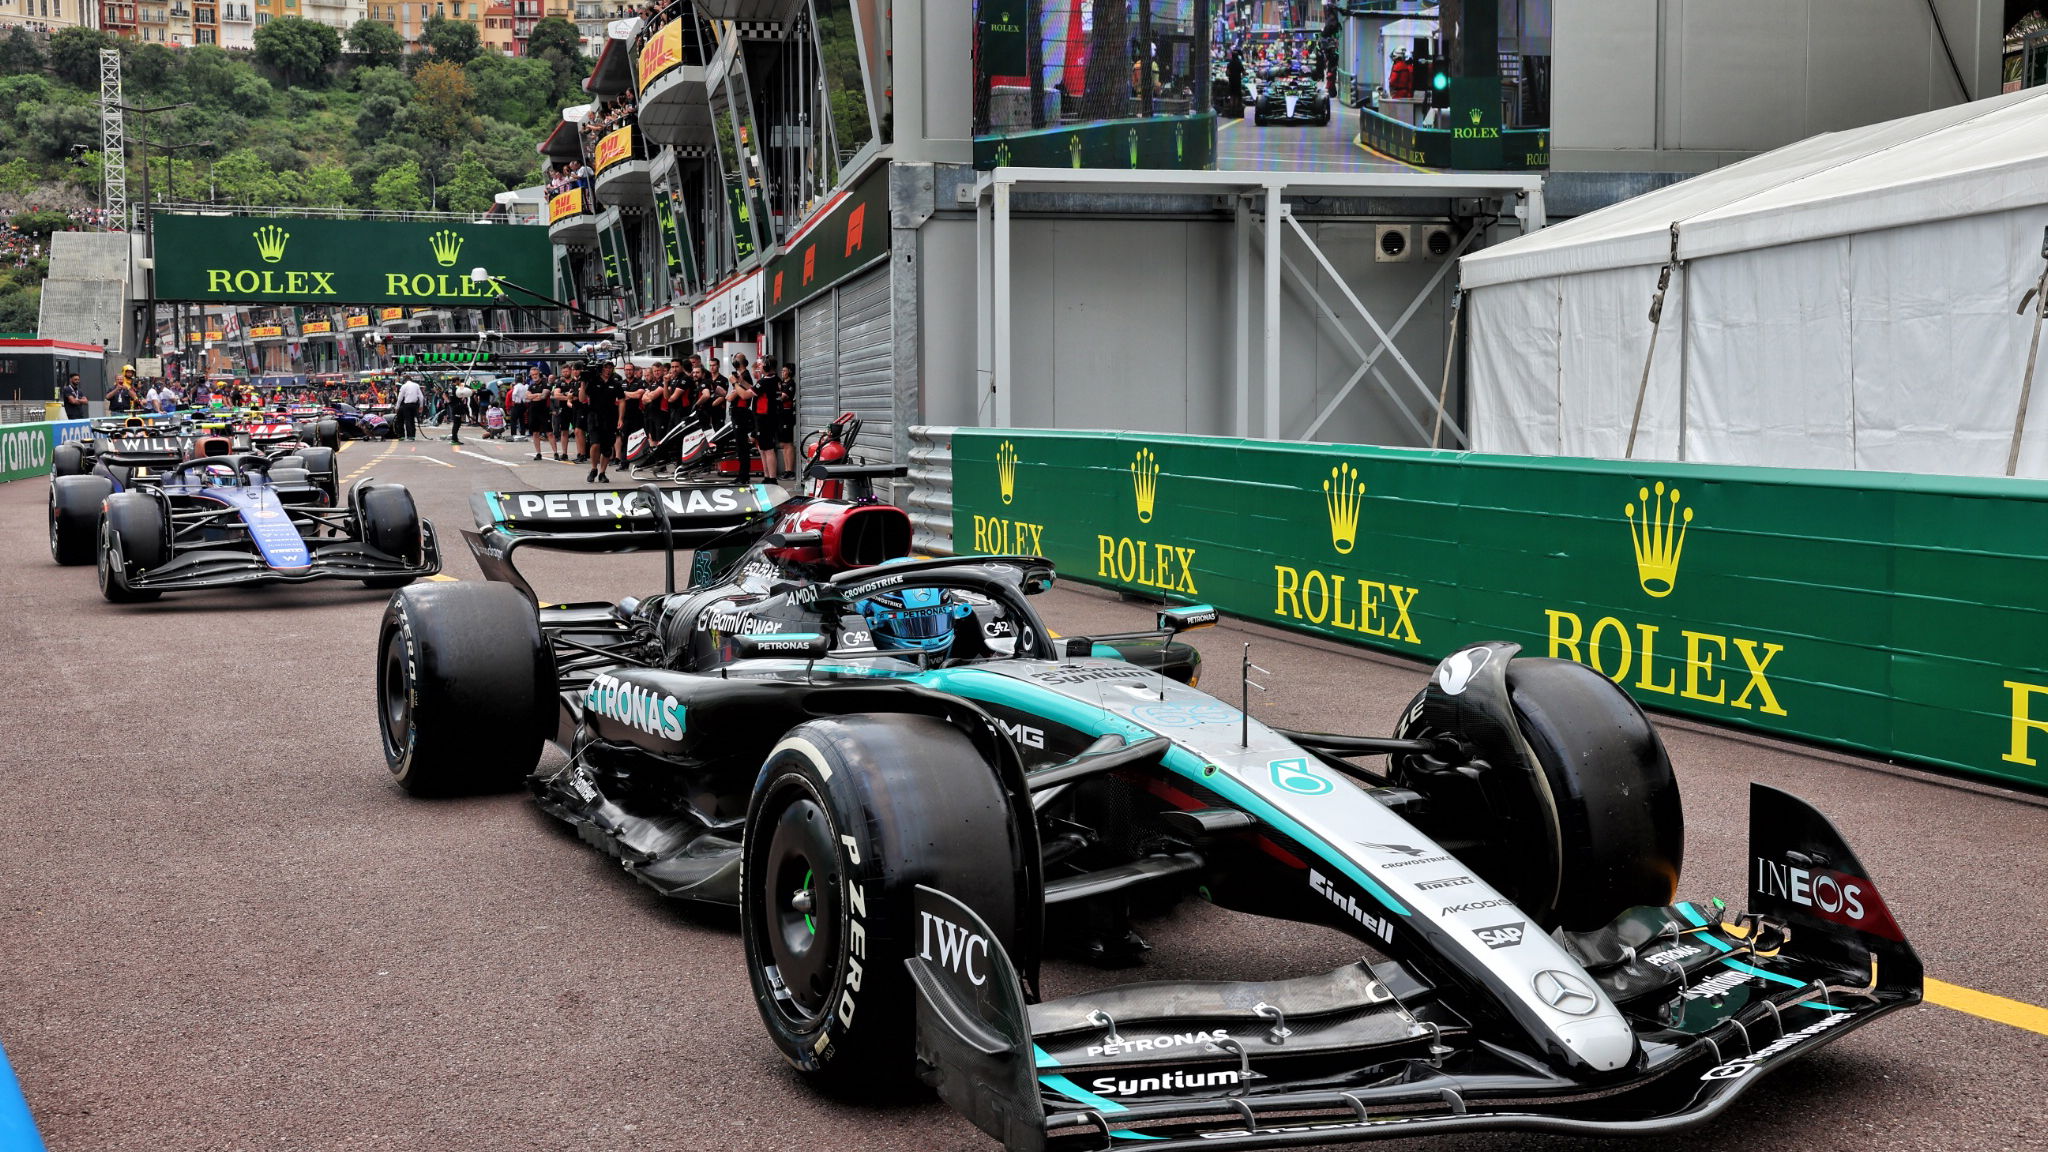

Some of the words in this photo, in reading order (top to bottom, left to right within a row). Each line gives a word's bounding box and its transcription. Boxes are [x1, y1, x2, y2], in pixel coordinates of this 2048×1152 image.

[1453, 127, 1499, 138] ROLEX
[207, 270, 337, 295] ROLEX
[385, 274, 507, 298] ROLEX
[0, 430, 46, 473] ramco
[973, 515, 1044, 557] ROLEX
[1097, 534, 1198, 595] ROLEX
[786, 587, 811, 607] AMD
[843, 575, 904, 599] CROWDSTRIKE
[903, 607, 947, 618] PETRONAS
[1274, 565, 1422, 644] ROLEX
[709, 606, 783, 635] TeamViewer
[1187, 613, 1216, 624] PETRONAS
[401, 610, 417, 681] ZERO
[757, 641, 810, 650] PETRONAS
[1545, 609, 1788, 717] ROLEX
[1041, 669, 1156, 686] Syntium
[584, 673, 684, 742] ETRONAS
[841, 834, 860, 866] P
[1380, 855, 1454, 870] CROWDSTRIKE
[1414, 875, 1474, 891] PIRELLI
[1756, 856, 1865, 921] INEOS
[1309, 867, 1394, 945] Einhell
[920, 910, 989, 986] IWC
[1478, 927, 1522, 946] SAP
[838, 880, 867, 1030] ZERO
[1644, 945, 1702, 968] PETRONAS
[1087, 1029, 1230, 1058] PETRONAS
[1092, 1070, 1239, 1096] Syntium
